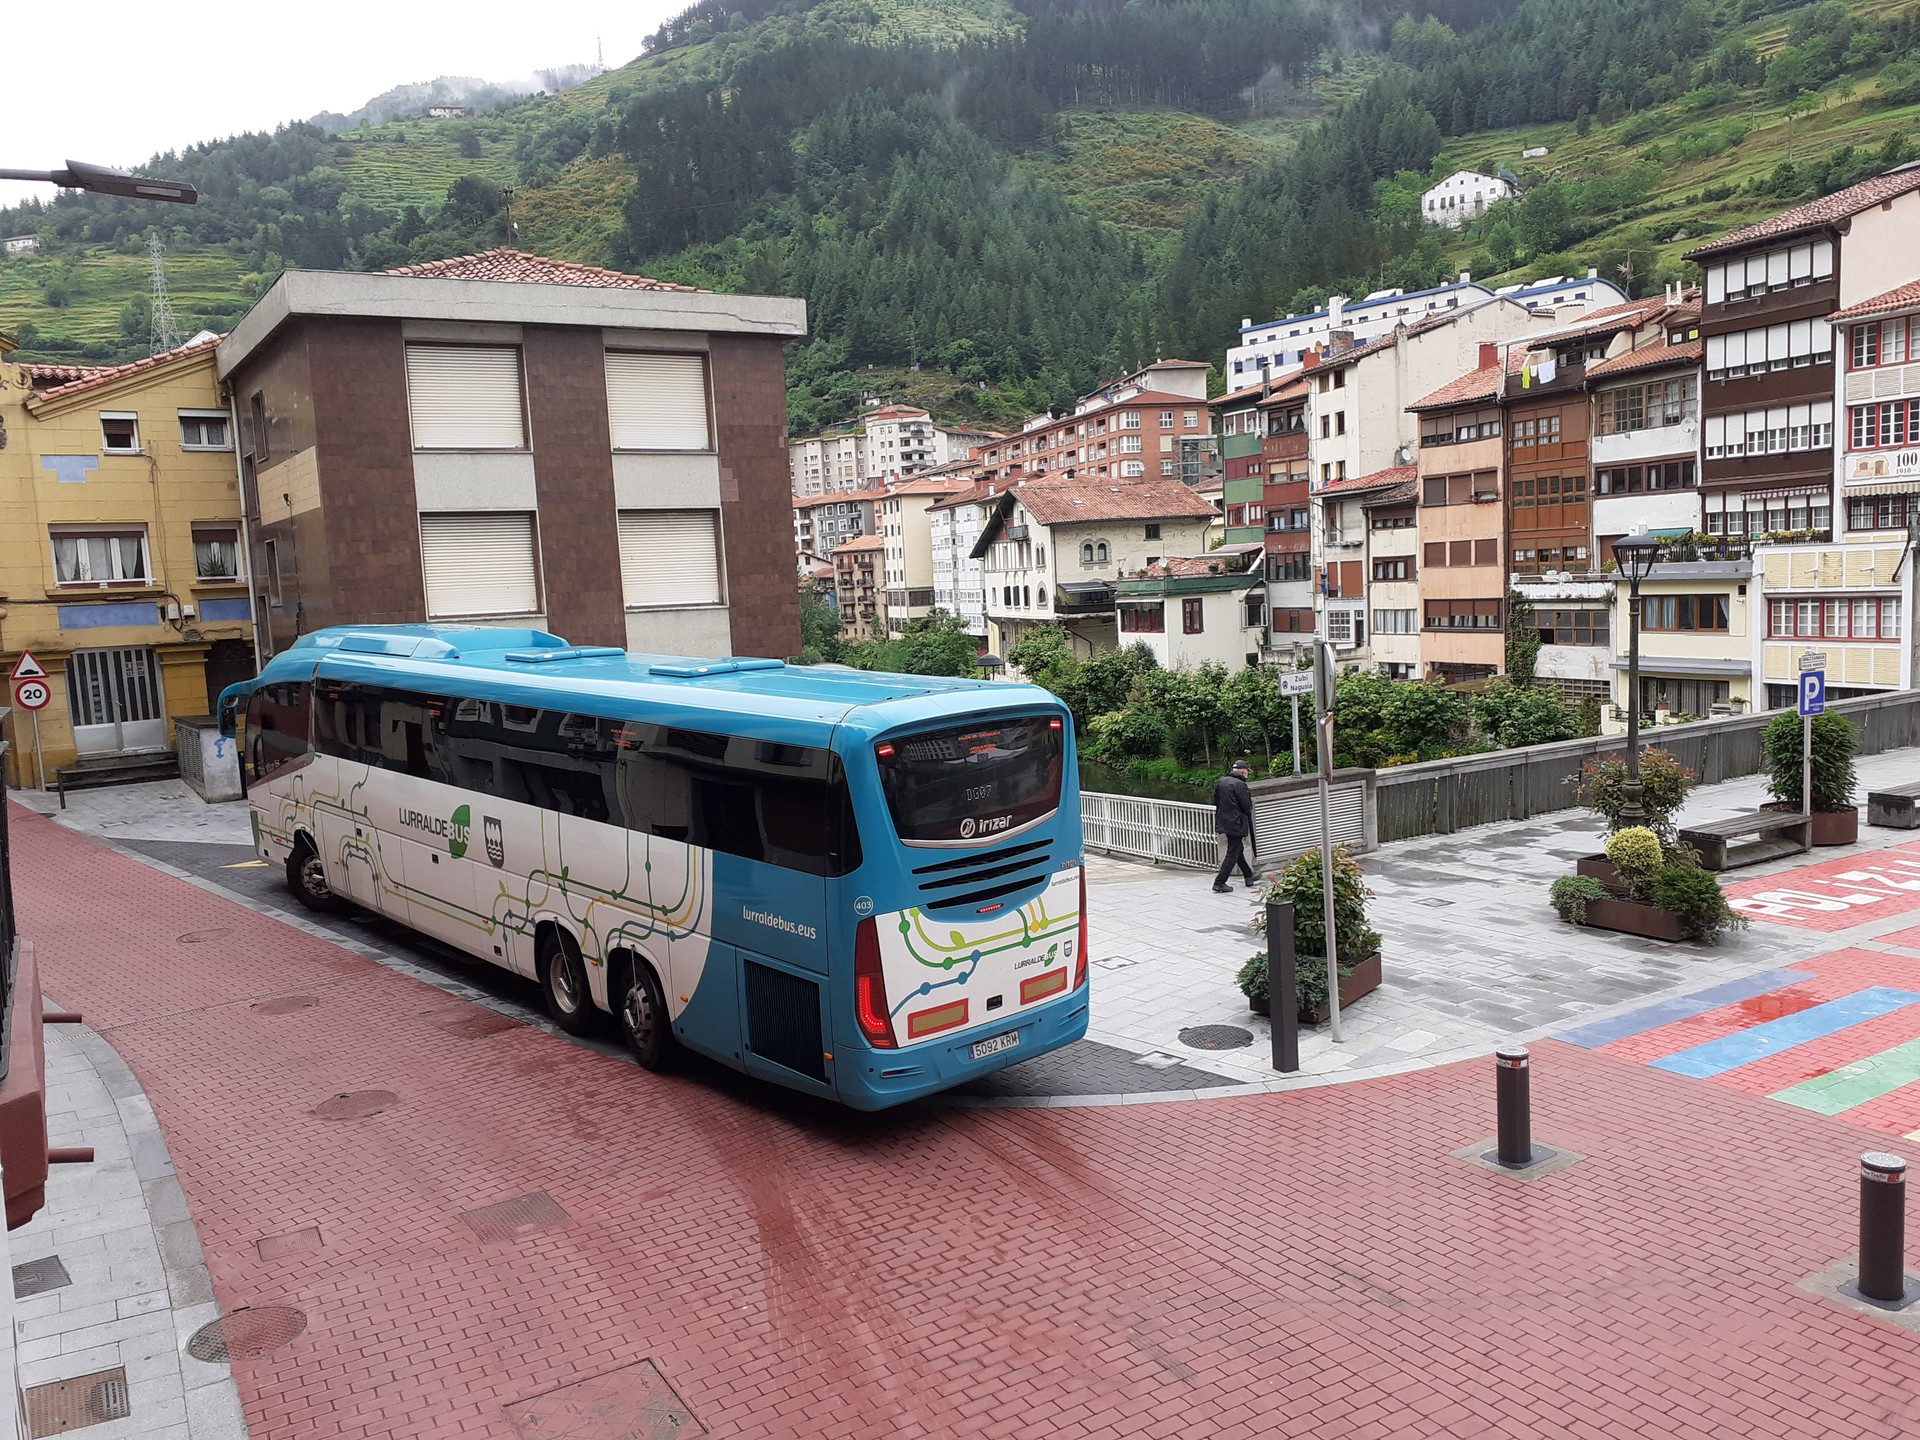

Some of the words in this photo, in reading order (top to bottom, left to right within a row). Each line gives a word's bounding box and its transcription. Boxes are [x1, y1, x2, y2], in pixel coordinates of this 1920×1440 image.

[1896, 452, 1918, 467] 100
[1294, 674, 1308, 682] Zubi
[23, 688, 43, 700] 20
[1290, 684, 1312, 692] Nagusia
[1804, 676, 1820, 711] P
[398, 807, 471, 846] LURRALDEBUS
[855, 900, 872, 910] 403
[742, 905, 817, 940] lurraldebus.eus
[1014, 950, 1058, 970] LURRALDEBUS
[975, 1040, 999, 1057] 5092
